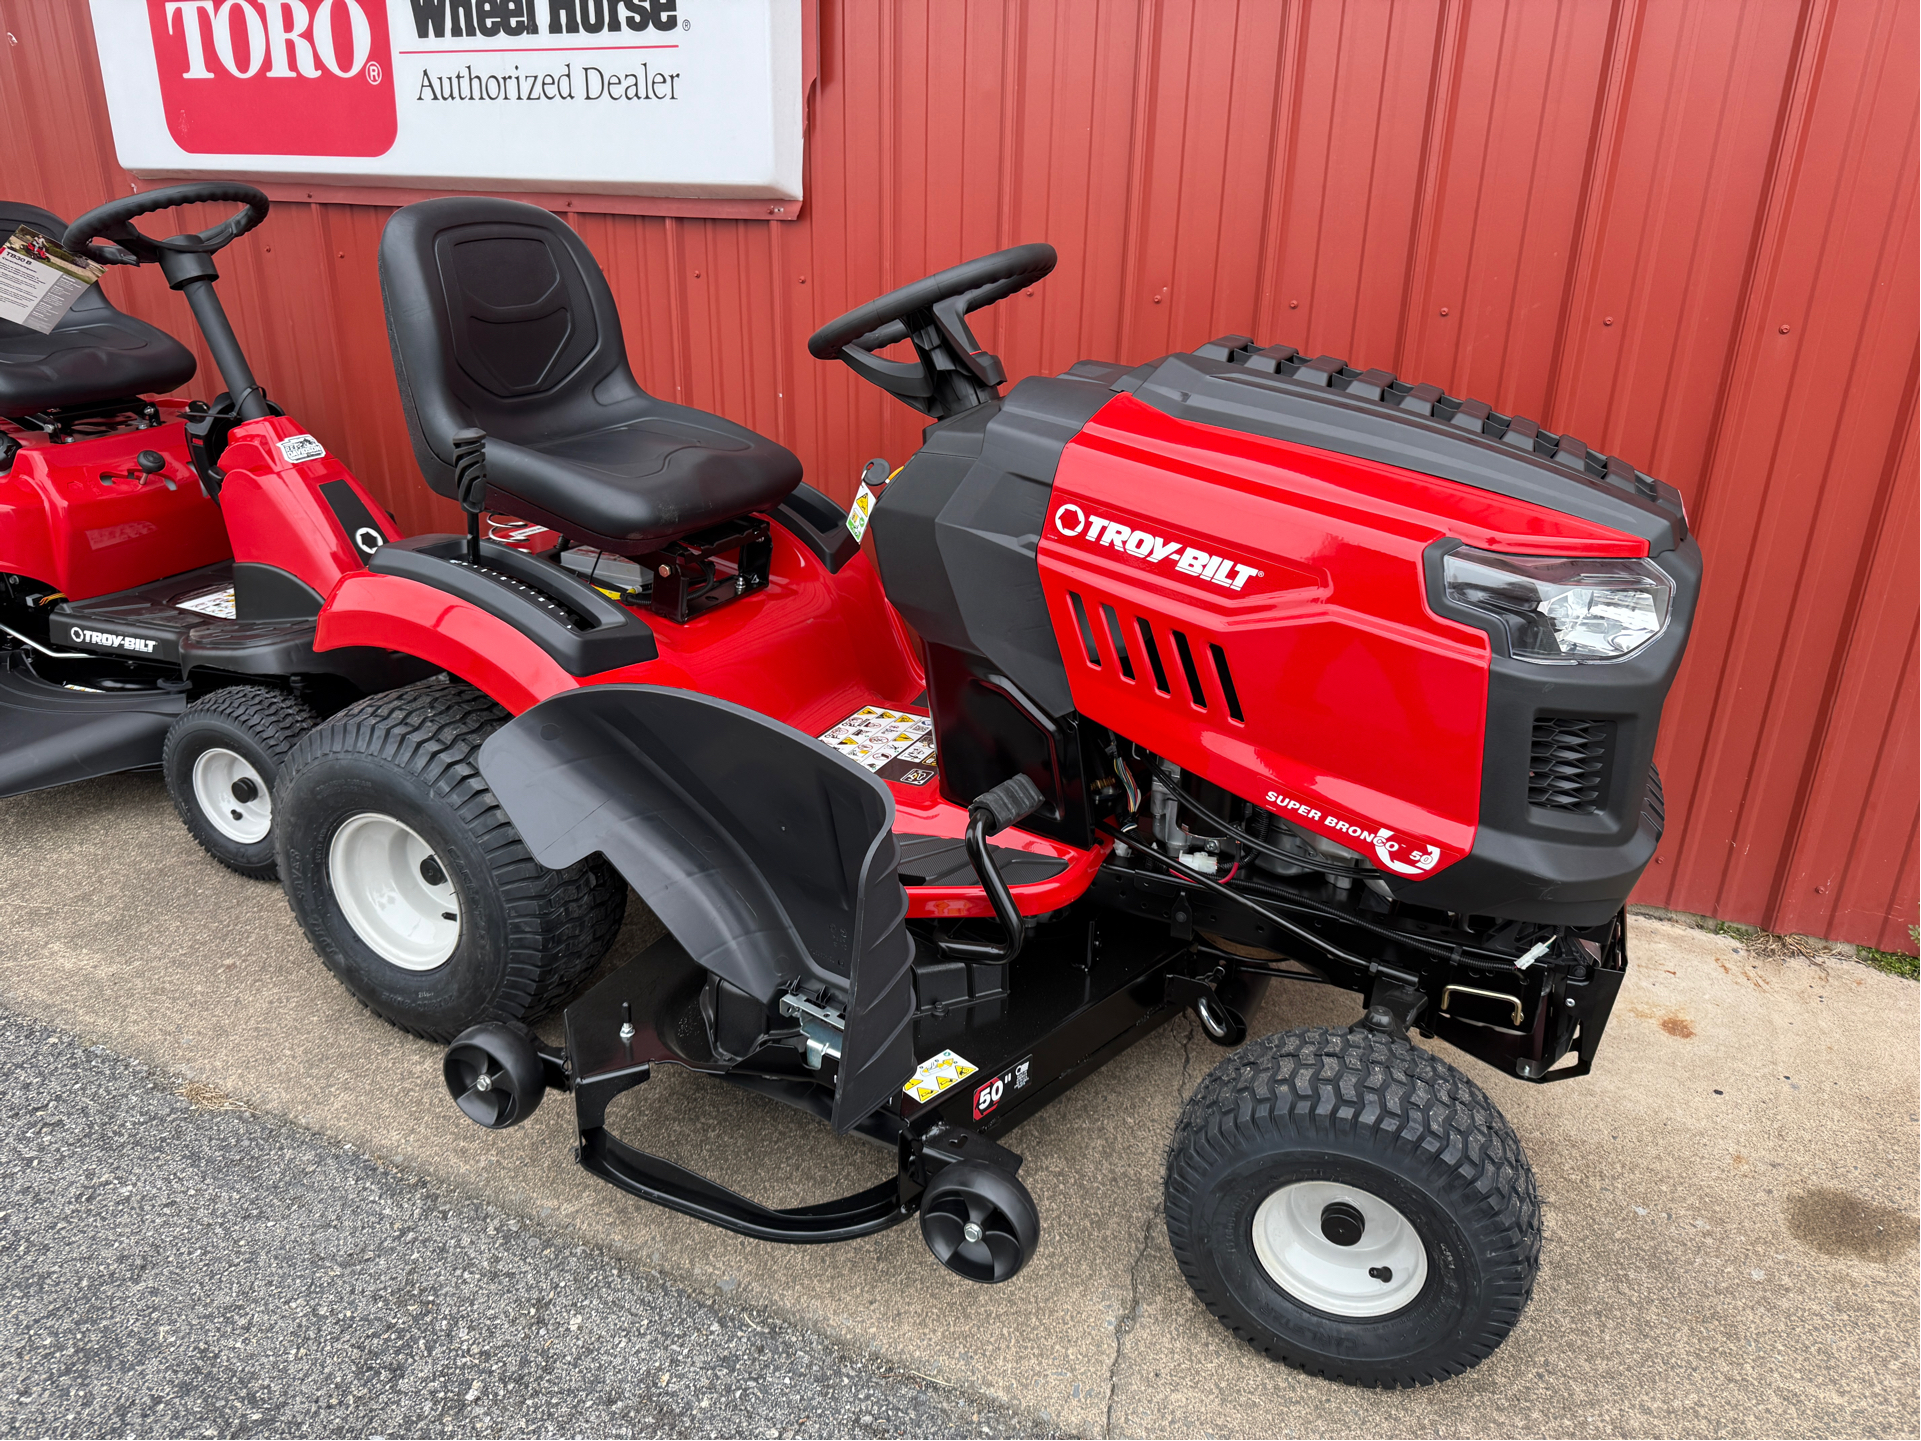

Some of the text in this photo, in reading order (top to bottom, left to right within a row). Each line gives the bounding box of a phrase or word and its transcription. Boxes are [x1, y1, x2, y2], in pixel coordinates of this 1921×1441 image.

[410, 0, 678, 38] Wheel Horse
[165, 0, 371, 78] TORO
[417, 62, 680, 101] Authorized Dealer
[1086, 515, 1259, 591] TROY-BILT
[84, 630, 156, 653] TROY-BILT
[1265, 790, 1399, 852] SUPER BRONCO
[1409, 850, 1433, 865] 50
